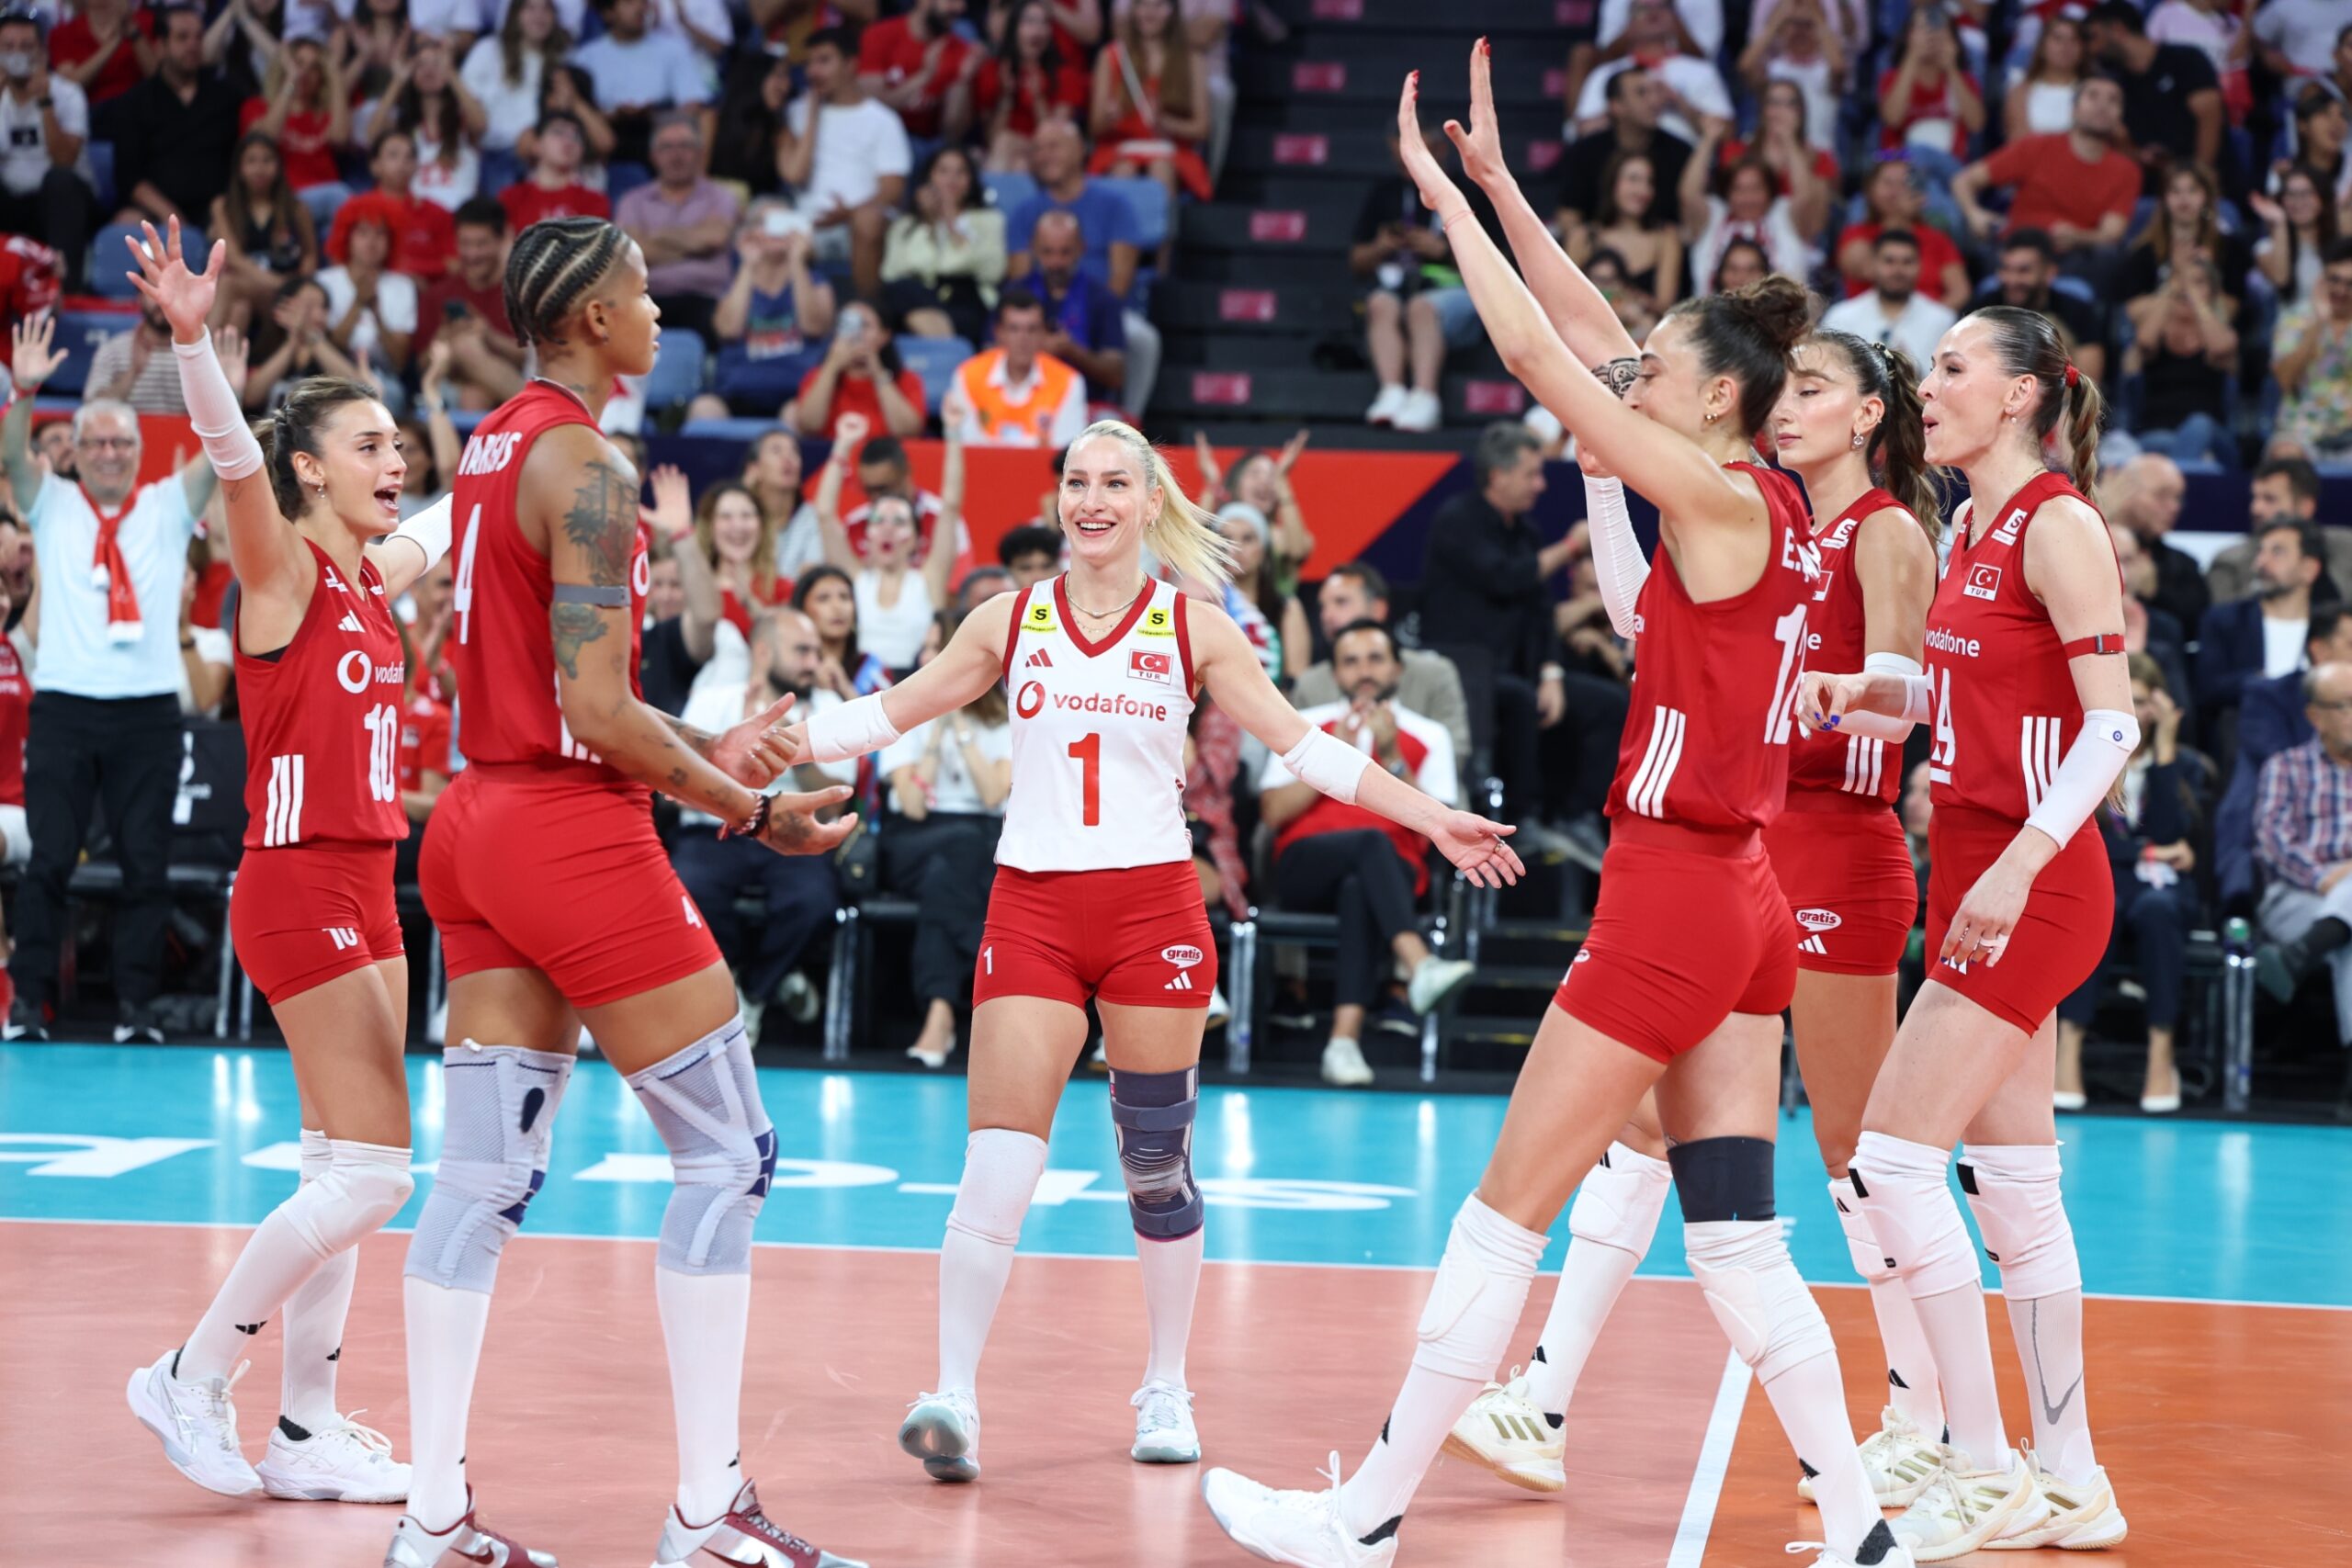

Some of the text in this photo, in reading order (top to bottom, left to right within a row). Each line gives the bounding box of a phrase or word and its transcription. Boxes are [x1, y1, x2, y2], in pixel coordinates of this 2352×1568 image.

[2010, 515, 2023, 528] S
[455, 503, 482, 645] 4
[1971, 588, 1988, 598] TUR
[1035, 608, 1047, 621] S
[1151, 613, 1164, 625] S
[1926, 626, 1980, 658] vodafone
[375, 661, 404, 683] vodaf
[1138, 671, 1161, 681] TUR
[1054, 693, 1167, 721] vodafone
[364, 703, 397, 803] 10
[1068, 732, 1101, 827] 1
[682, 896, 702, 929] 4
[1800, 910, 1837, 924] gratis
[983, 946, 993, 975] 1
[1167, 947, 1201, 962] gratis
